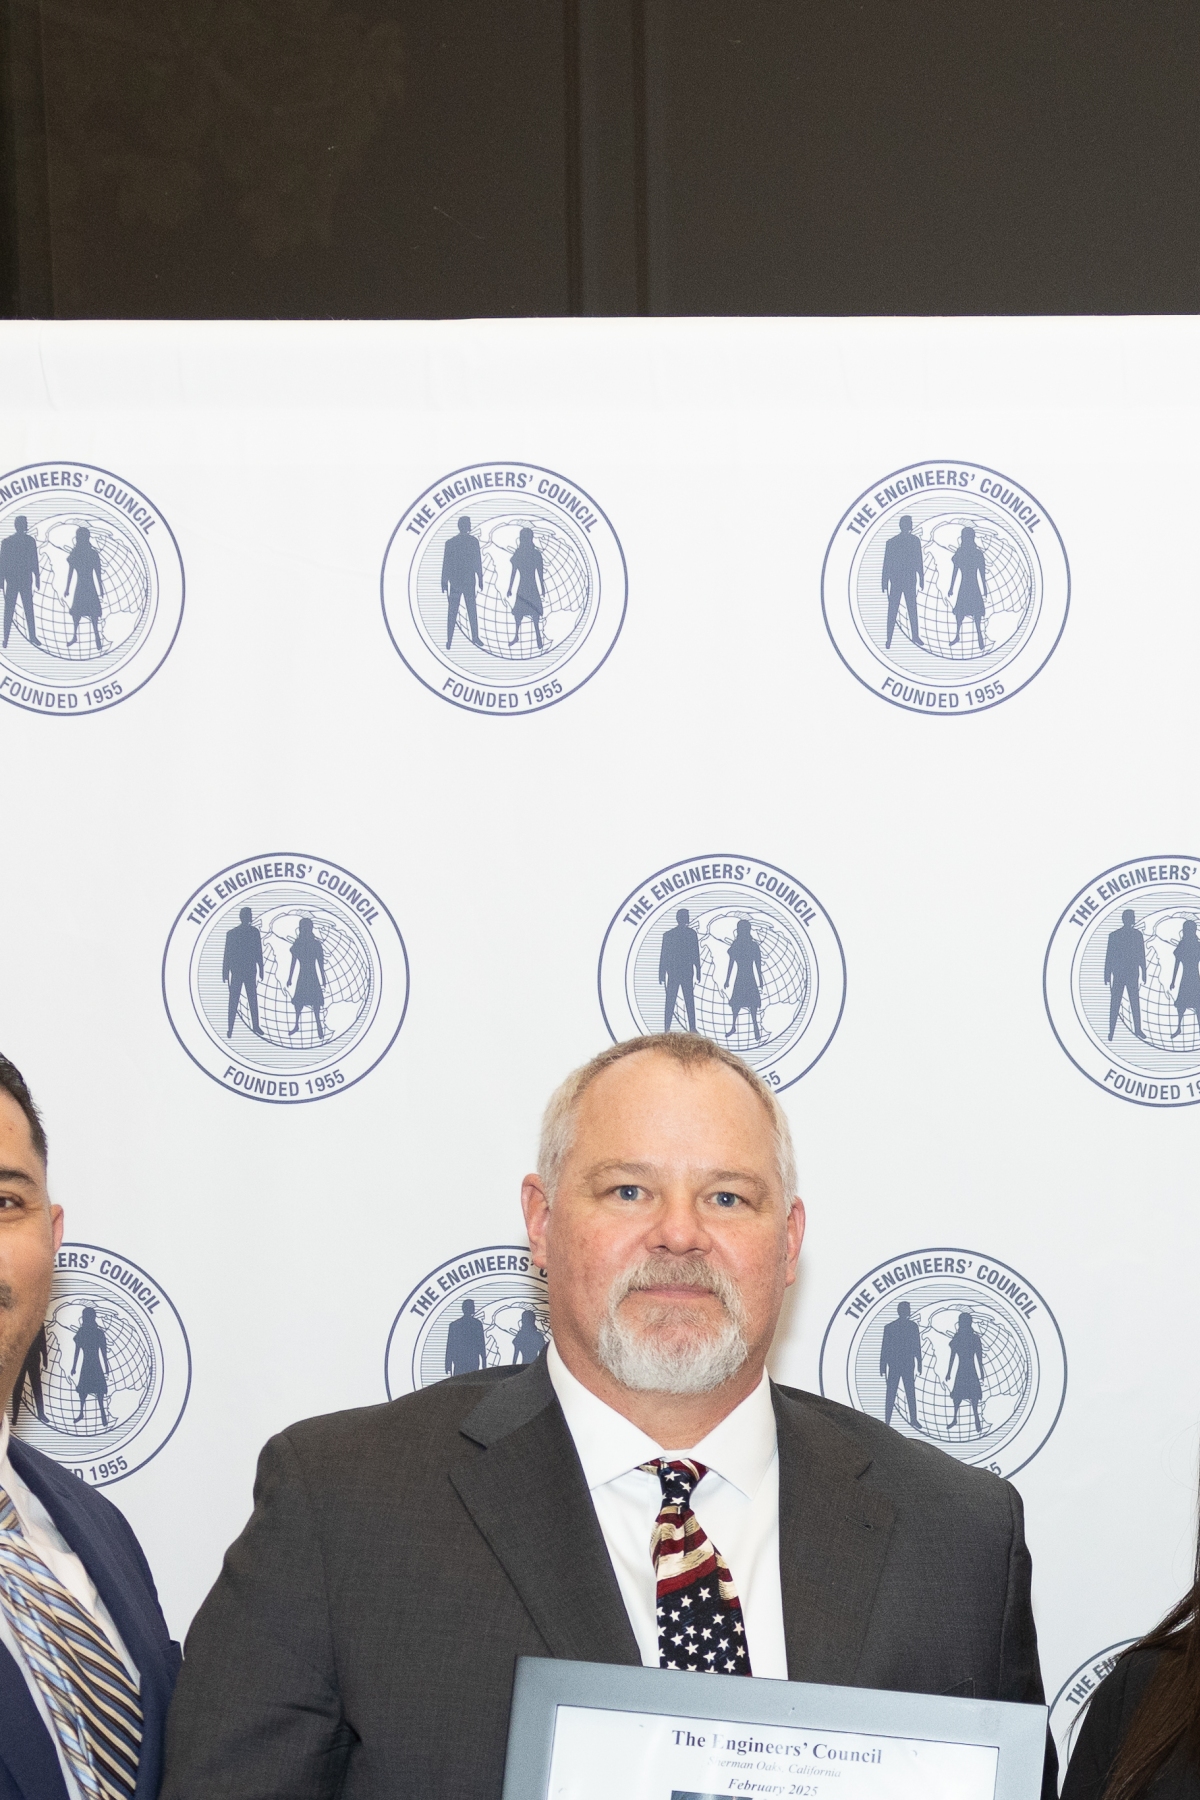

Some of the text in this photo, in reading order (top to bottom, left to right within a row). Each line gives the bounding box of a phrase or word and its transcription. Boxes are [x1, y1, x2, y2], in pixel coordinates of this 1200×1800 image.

[0, 469, 156, 535] NGINEERS' COUNCIL
[406, 470, 598, 537] THE ENGINEERS' COUNCIL
[846, 469, 1041, 535] THE ENGINEERS' COUNCIL
[0, 676, 123, 709] FOUNDED 1955
[442, 677, 564, 709] FOUNDED 1955
[881, 676, 1005, 709] FOUNDED 1955
[186, 861, 378, 926] THE ENGINEERS' COUNCIL
[623, 863, 816, 928] THE ENGINEERS' COUNCIL
[1069, 898, 1100, 930] THE
[1096, 863, 1198, 904] ENGINEERS'
[222, 1065, 345, 1097] FOUNDED 1955
[1103, 1069, 1182, 1101] FOUNDED
[99, 1260, 160, 1314] COUNCIL
[410, 1287, 440, 1318] THE
[845, 1256, 1037, 1320] THE ENGINEERS' COUNCIL
[90, 1455, 128, 1481] 1955
[1065, 1675, 1096, 1705] THE
[672, 1730, 882, 1764] The Engineers' Council
[728, 1778, 818, 1796] February 2025
[788, 1764, 842, 1778] California
